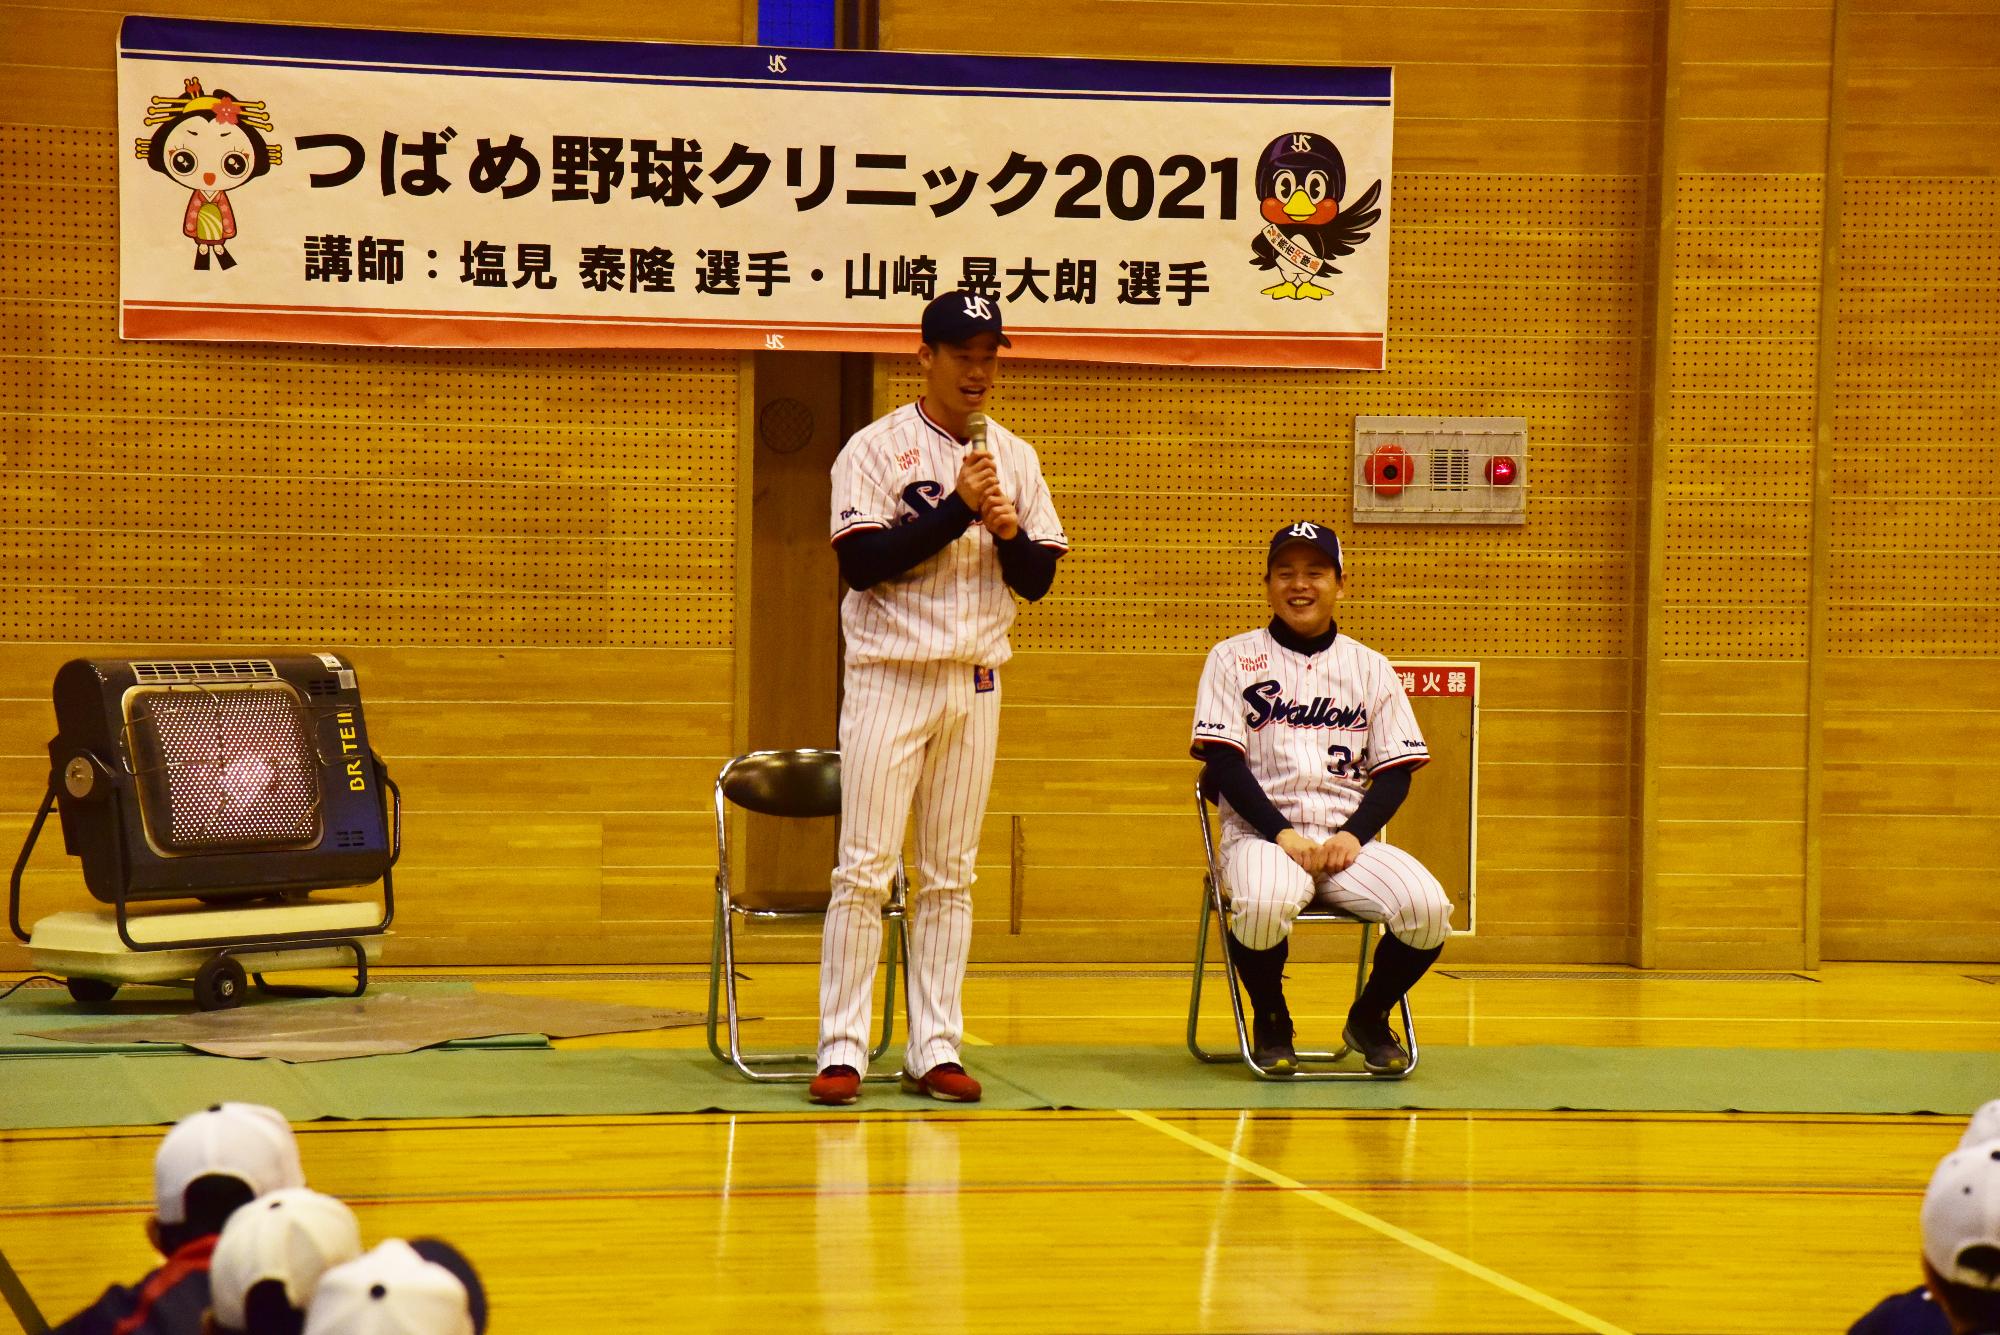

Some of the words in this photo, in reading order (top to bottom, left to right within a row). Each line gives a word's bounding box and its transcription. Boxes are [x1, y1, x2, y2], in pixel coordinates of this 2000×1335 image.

[294, 126, 1238, 221] つばめ野球クリニック2021
[579, 245, 675, 293] 泰隆
[957, 257, 1096, 304] 晃大朗
[1117, 260, 1209, 306] 選手
[1397, 672, 1466, 693] 消火器
[1195, 720, 1225, 730] kyo
